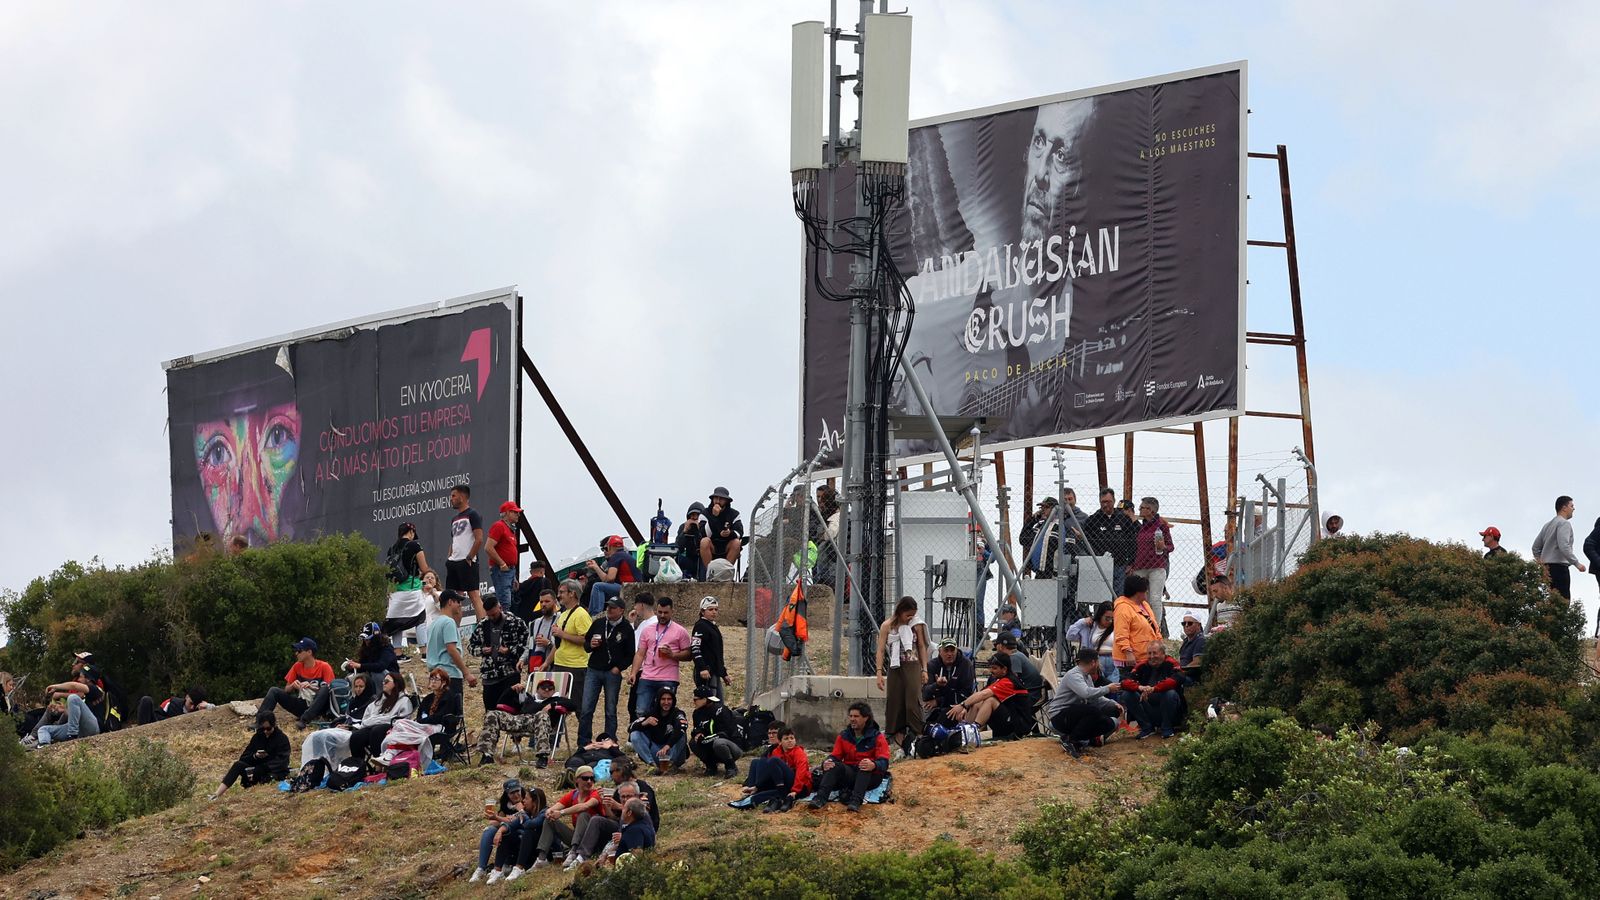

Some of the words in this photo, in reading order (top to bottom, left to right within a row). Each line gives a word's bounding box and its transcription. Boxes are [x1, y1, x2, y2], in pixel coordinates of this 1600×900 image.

[1155, 132, 1167, 143] NO
[1171, 123, 1216, 140] ESCUCHES
[1139, 150, 1145, 159] A
[1149, 146, 1166, 158] LOS
[1170, 137, 1216, 153] MAESTROS
[965, 367, 998, 383] PACO
[1007, 364, 1021, 377] DE
[400, 384, 417, 407] EN
[419, 373, 472, 403] KYOCERA
[319, 416, 399, 452] CONDUCIMOS
[402, 414, 417, 435] TU
[420, 403, 472, 433] EMPRESA
[316, 462, 324, 480] A
[326, 457, 341, 481] LO
[343, 448, 368, 476] MÁS
[371, 446, 400, 473] ALTO
[402, 442, 424, 465] DEL
[427, 433, 471, 461] PÓDIUM
[372, 489, 382, 503] TU
[383, 479, 420, 501] ESCUDERÍA
[421, 480, 436, 493] SON
[436, 472, 471, 491] NUESTRAS
[373, 505, 416, 522] SOLUCIONES
[416, 495, 452, 514] DOCUMEN
